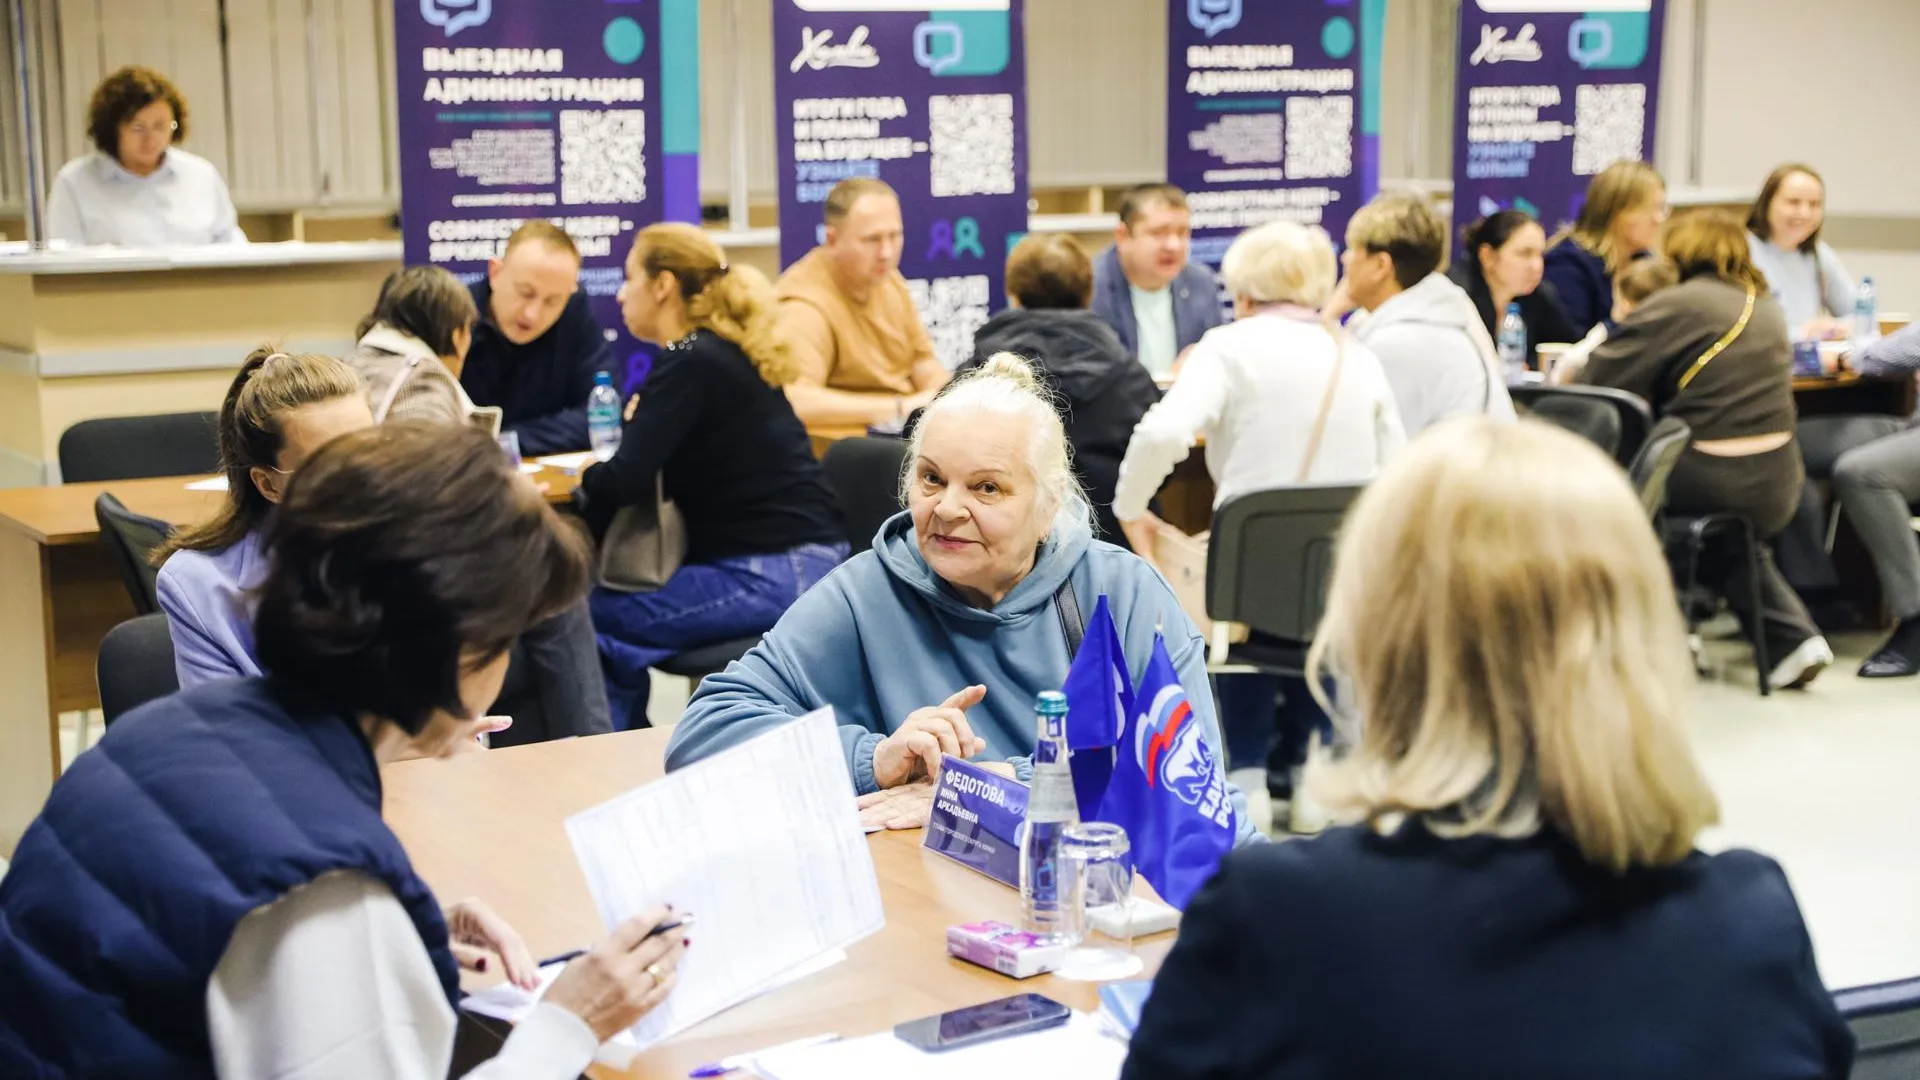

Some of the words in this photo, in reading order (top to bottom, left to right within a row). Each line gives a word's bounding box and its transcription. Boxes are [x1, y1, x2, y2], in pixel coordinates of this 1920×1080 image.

[423, 47, 563, 75] ВЫЕЗДНАЯ
[1186, 45, 1294, 69] ВЫЕЗДНАЯ
[423, 77, 645, 104] АДМИНИСТРАЦИЯ
[1186, 69, 1354, 95] АДМИНИСТРАЦИЯ
[793, 98, 855, 120] ИТОГИ
[855, 96, 908, 120] ГОДА
[811, 118, 880, 140] ПЛАНЫ
[794, 140, 822, 161] НА
[823, 137, 913, 160] БУДУЩЕЕ
[945, 769, 1005, 805] ФЕДОТОВА
[937, 799, 979, 823] АРКАДЬЕВНА
